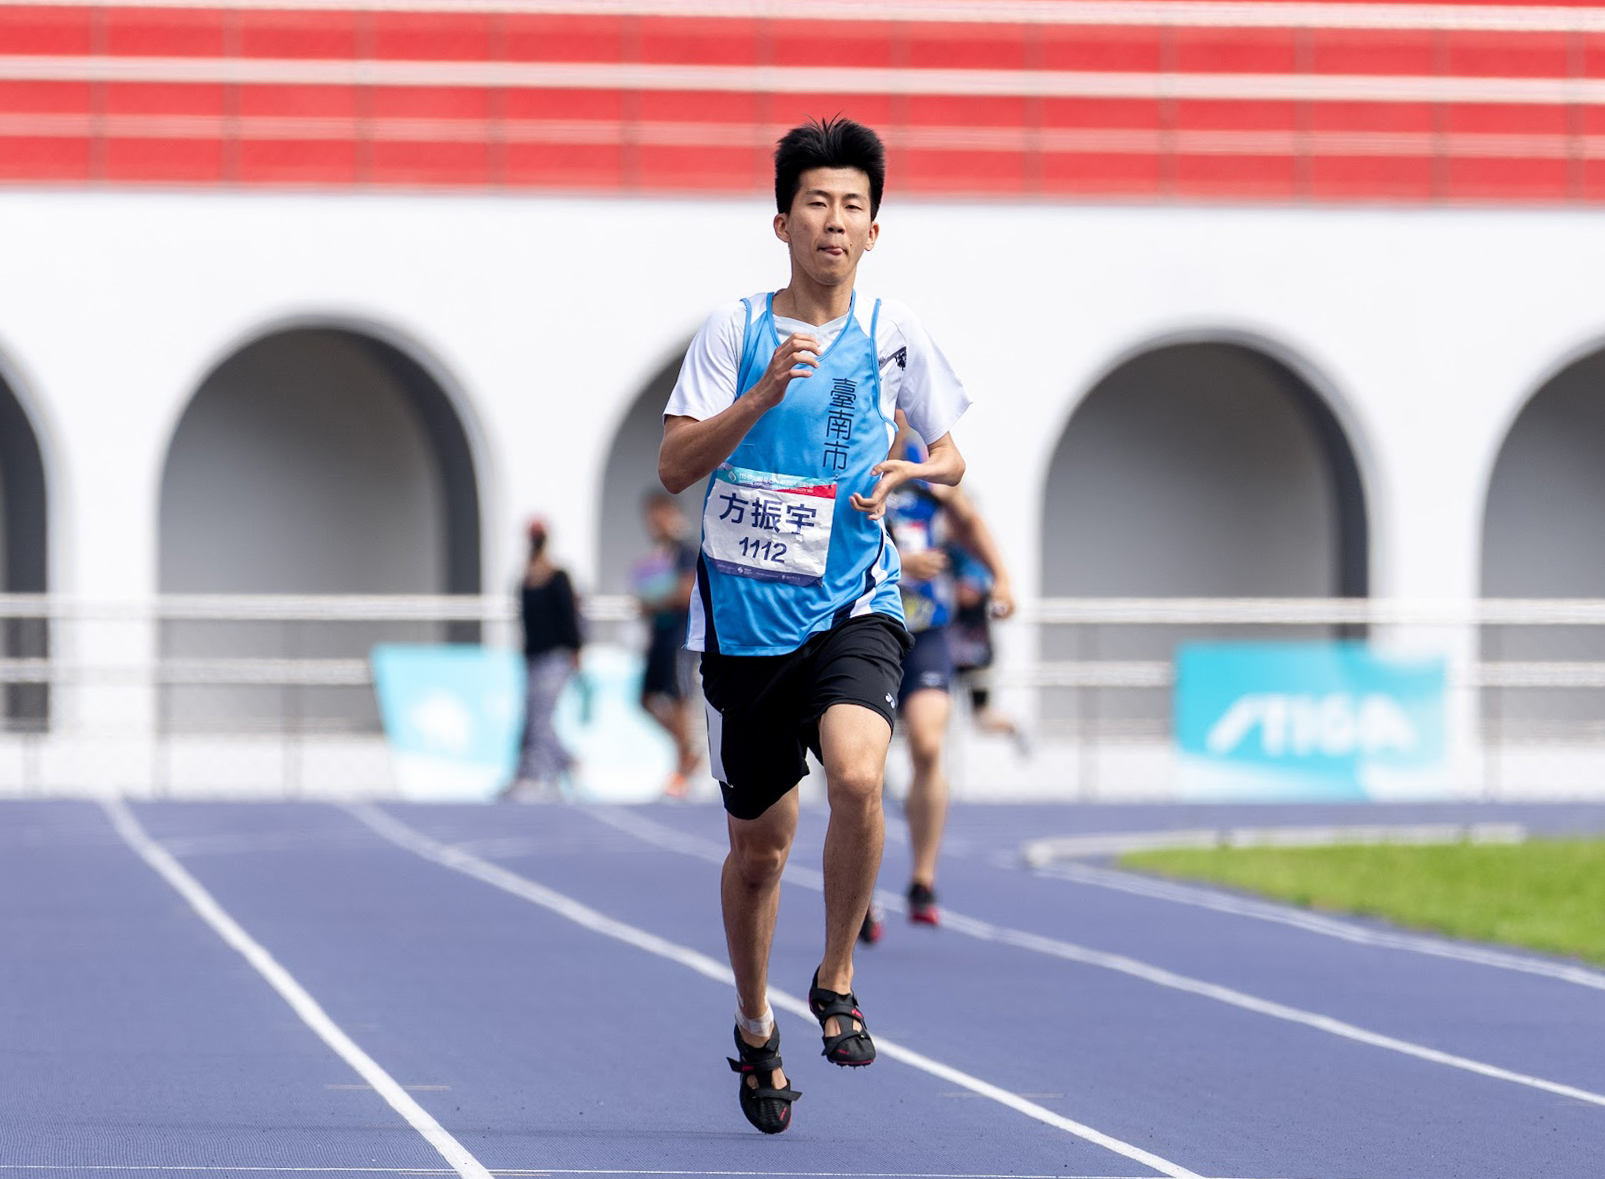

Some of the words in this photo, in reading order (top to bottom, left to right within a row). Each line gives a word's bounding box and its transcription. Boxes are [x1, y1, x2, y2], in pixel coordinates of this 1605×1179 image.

[822, 377, 858, 471] 臺南市
[719, 492, 817, 534] 方振宇
[739, 536, 788, 564] 1112
